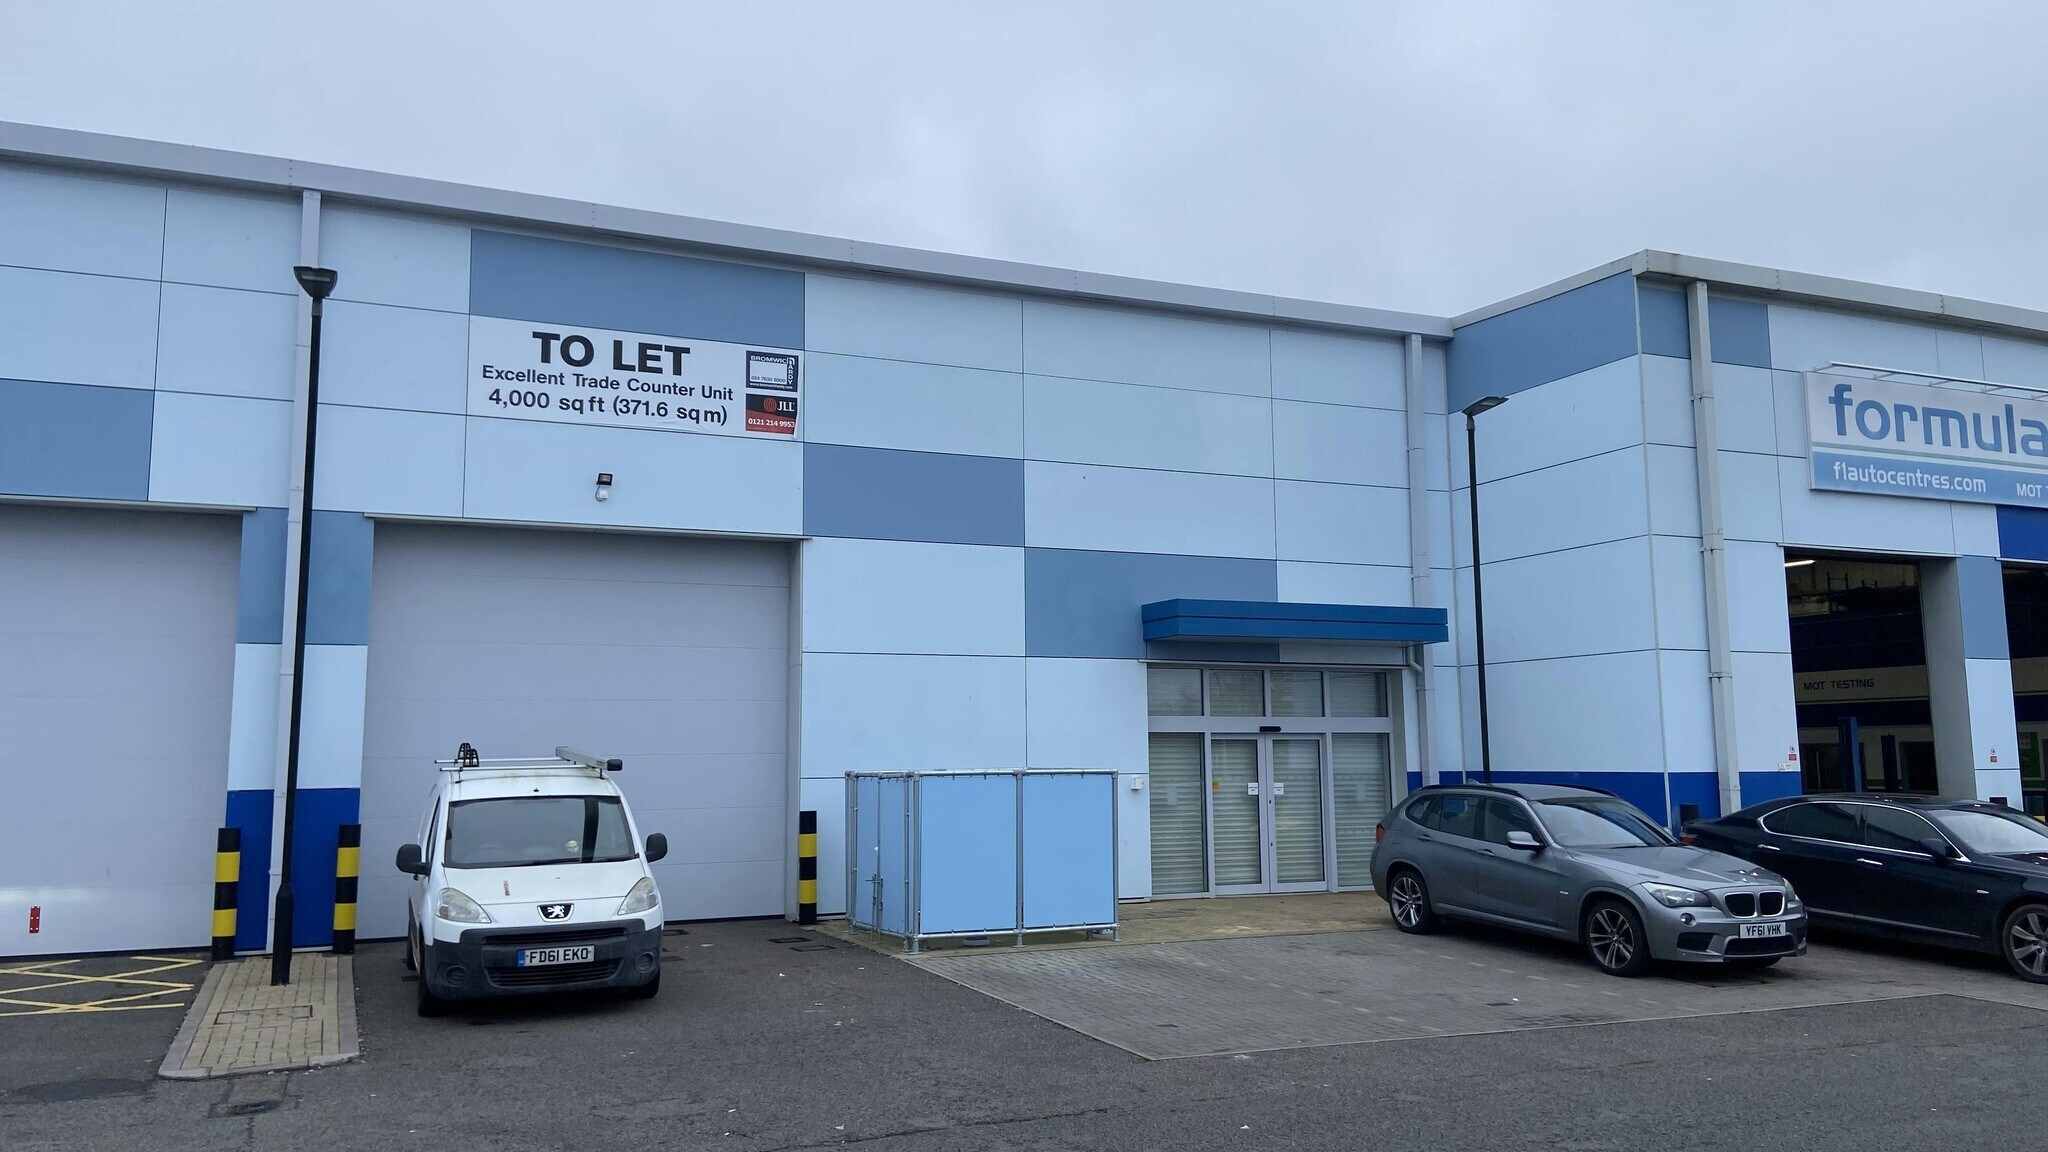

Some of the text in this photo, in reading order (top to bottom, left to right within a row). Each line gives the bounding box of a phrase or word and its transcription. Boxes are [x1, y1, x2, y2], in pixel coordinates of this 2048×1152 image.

[532, 331, 691, 376] TO LET
[482, 365, 734, 401] Excellent Trade Counter Unit
[488, 388, 550, 409] 4,000
[612, 395, 668, 418] (371.6
[777, 400, 795, 412] JLL
[748, 418, 795, 428] 0121 214 9953
[1828, 383, 2048, 458] formula
[1833, 461, 1987, 493] f1autocentres.com
[2016, 482, 2042, 498] MOT
[1803, 678, 1875, 691] MOT TESTING
[1746, 924, 1781, 936] YF61 VHK
[529, 947, 589, 963] FD61 EKO
